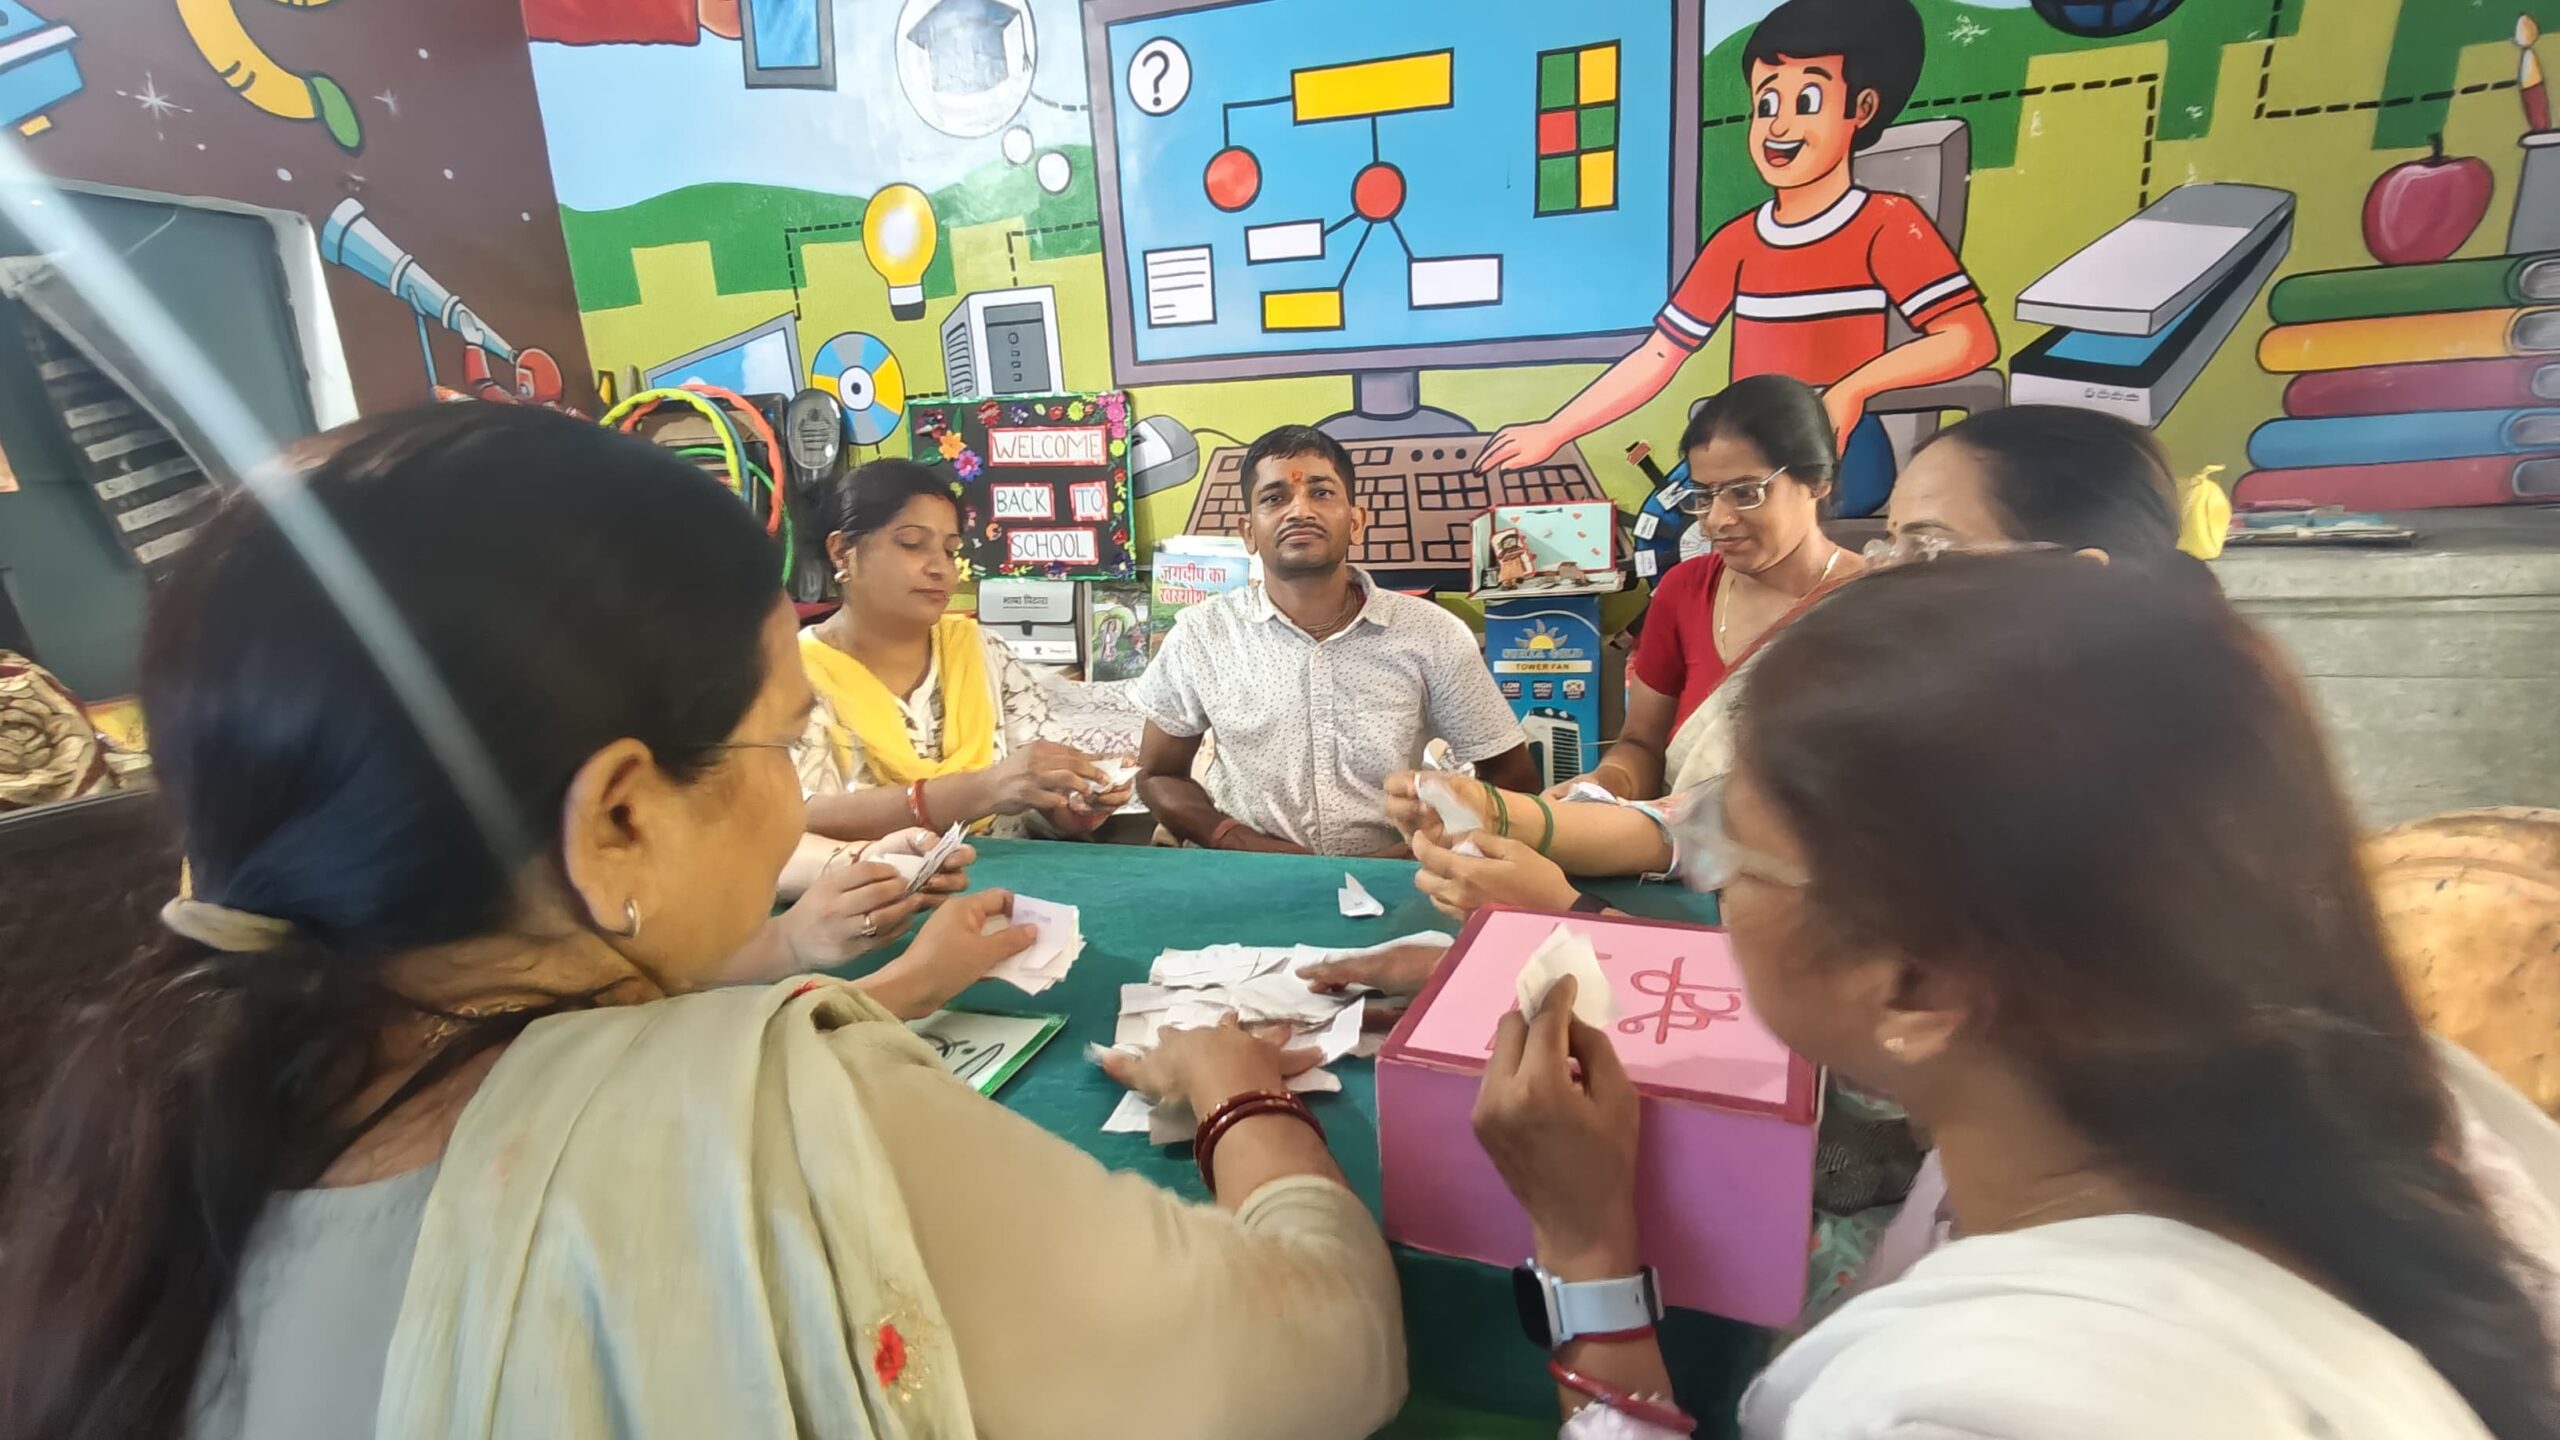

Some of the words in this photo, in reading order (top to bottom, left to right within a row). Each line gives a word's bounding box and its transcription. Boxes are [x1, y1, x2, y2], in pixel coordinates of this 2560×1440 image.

[1142, 50, 1170, 107] ?
[992, 433, 1100, 459] WELCOME
[995, 489, 1048, 513] BACK
[1075, 488, 1104, 513] TO
[1011, 533, 1087, 559] SCHOOL
[1208, 567, 1226, 584] का
[1515, 663, 1549, 671] TOWER
